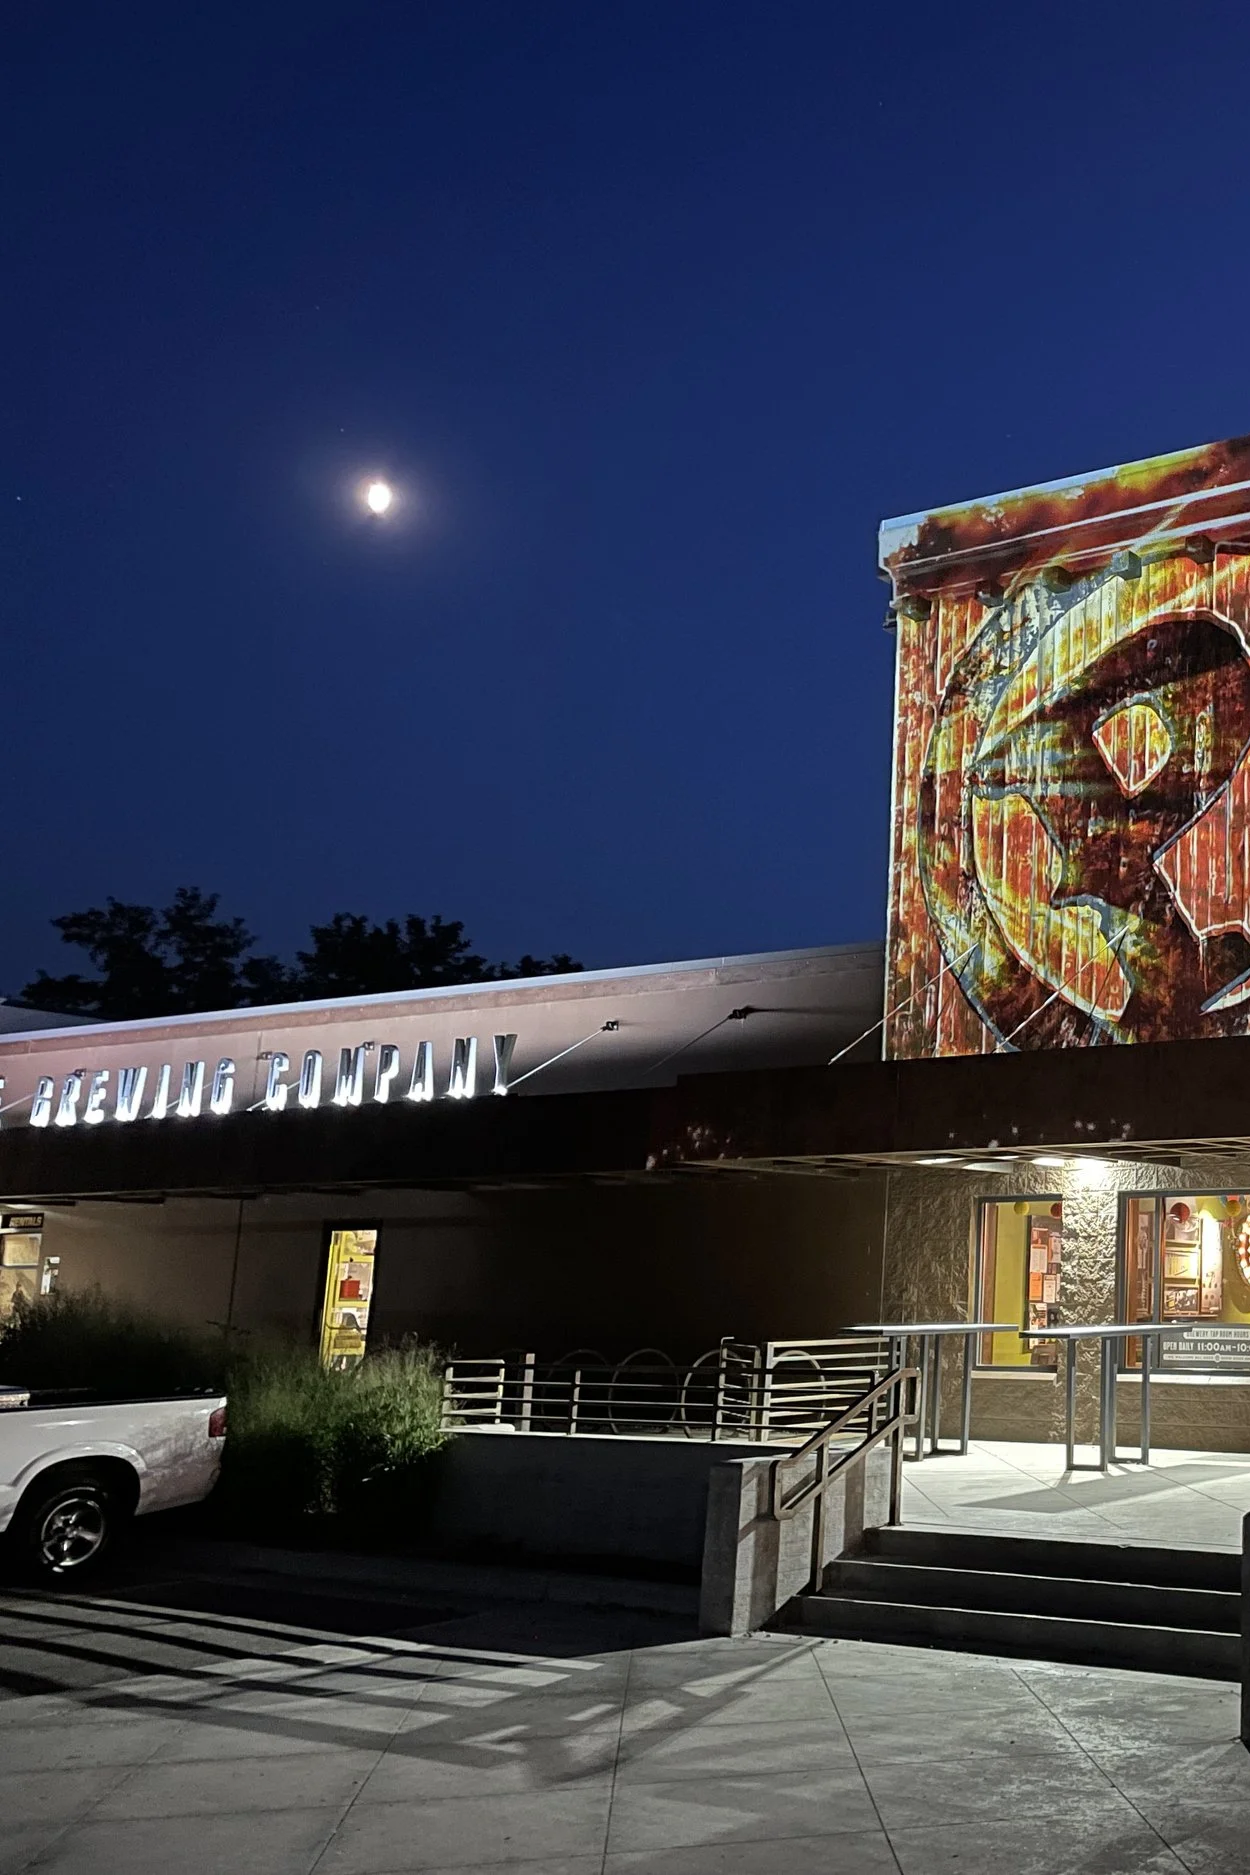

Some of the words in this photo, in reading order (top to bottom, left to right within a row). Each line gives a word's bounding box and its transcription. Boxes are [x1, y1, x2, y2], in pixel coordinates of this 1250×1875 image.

[29, 1056, 236, 1128] BREWING
[264, 1034, 519, 1111] COMPANY
[1162, 1341, 1178, 1351] OPEN
[1178, 1341, 1195, 1351] DAILY
